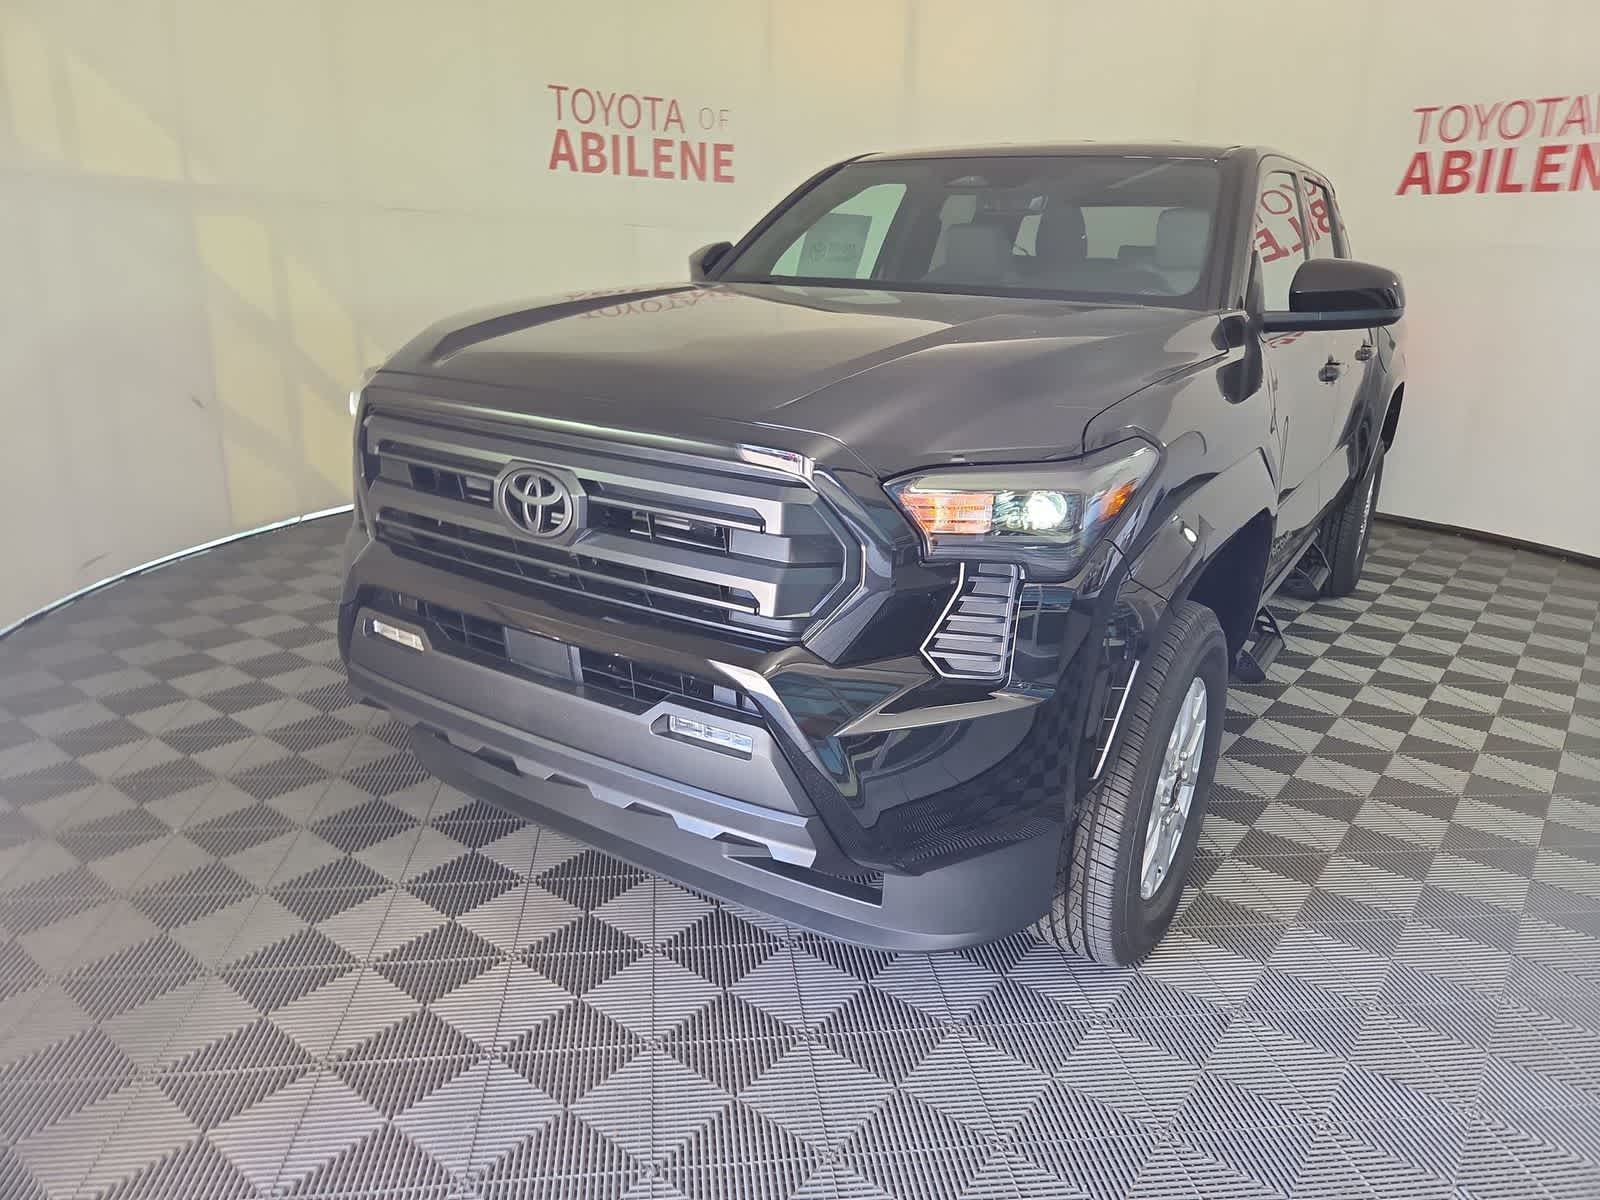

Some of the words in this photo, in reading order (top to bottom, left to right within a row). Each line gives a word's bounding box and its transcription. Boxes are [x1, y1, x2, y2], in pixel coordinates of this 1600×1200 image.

[547, 84, 685, 133] TOYOTA
[699, 106, 732, 131] OF
[547, 128, 736, 183] ABILENE
